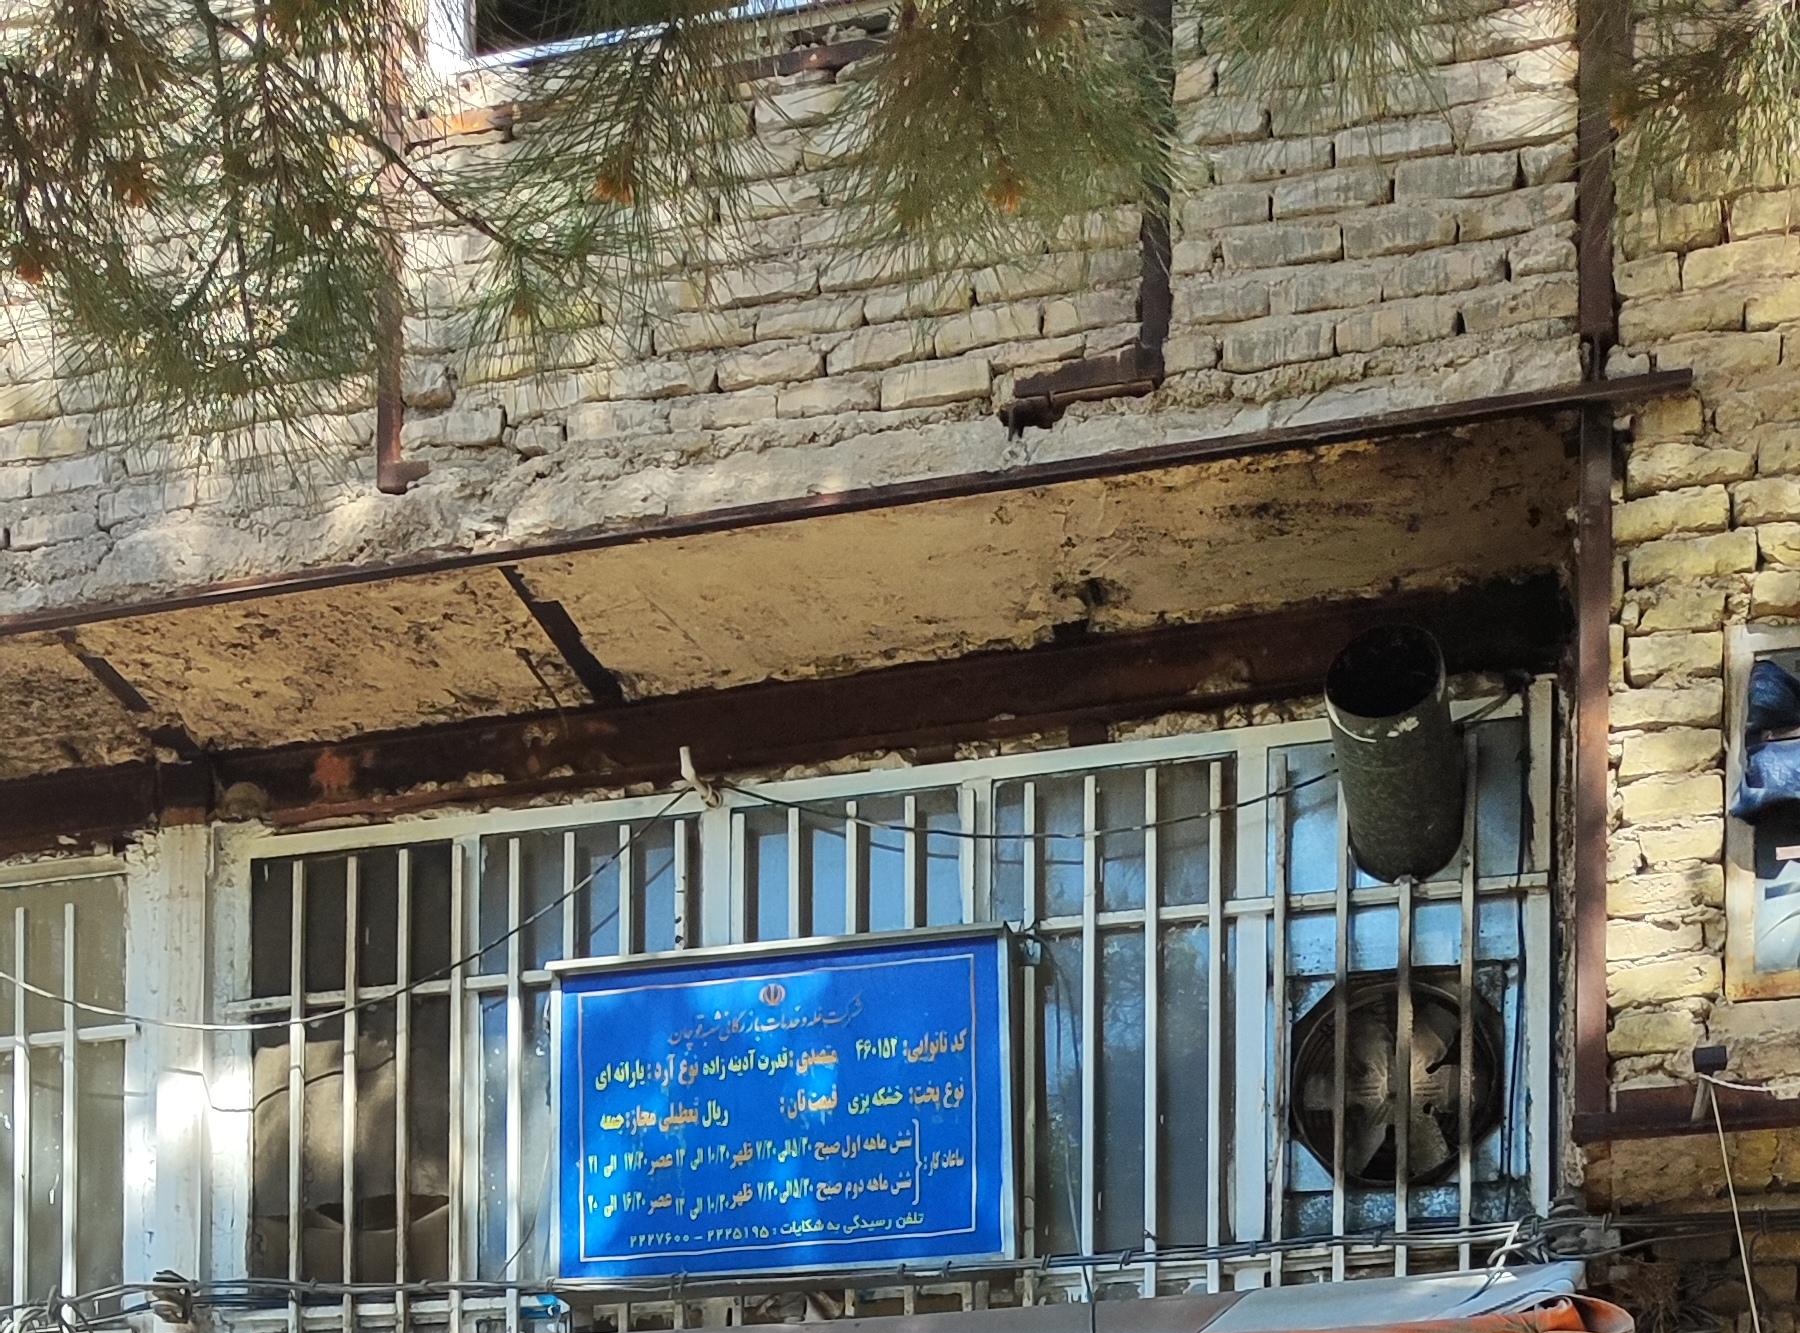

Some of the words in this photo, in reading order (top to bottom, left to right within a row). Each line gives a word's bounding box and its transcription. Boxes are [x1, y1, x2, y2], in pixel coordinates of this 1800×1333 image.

[951, 1028, 968, 1052] کد
[595, 1063, 612, 1091] ای
[614, 1059, 645, 1089] یارانه
[678, 1051, 700, 1085] نوع
[702, 1056, 727, 1081] زاده
[808, 1083, 838, 1112] قیمت
[872, 1085, 904, 1107] خشکه
[942, 1077, 965, 1109] نوع
[600, 1113, 626, 1136] جمعه
[659, 1097, 700, 1132] تعطیلی
[702, 1100, 729, 1128] ریال
[814, 1140, 841, 1160] صبح
[841, 1134, 861, 1158] اول
[863, 1133, 888, 1151] ماهه
[889, 1129, 913, 1153] شش
[603, 1154, 618, 1178] الی
[647, 1153, 674, 1176] عصر
[690, 1147, 704, 1171] الی
[730, 1141, 754, 1169] ظهر
[816, 1180, 843, 1201] صبح
[845, 1178, 865, 1199] دوم
[866, 1172, 889, 1192] ماهه
[890, 1171, 913, 1195] شش
[603, 1194, 618, 1218] الی
[647, 1193, 673, 1216] عصر
[729, 1182, 754, 1209] ظهر
[689, 1197, 704, 1220] الی
[895, 1212, 925, 1229] تلفن
[780, 1218, 825, 1237] شکایات
[826, 1221, 841, 1233] به
[843, 1214, 893, 1235] رسیدگی
